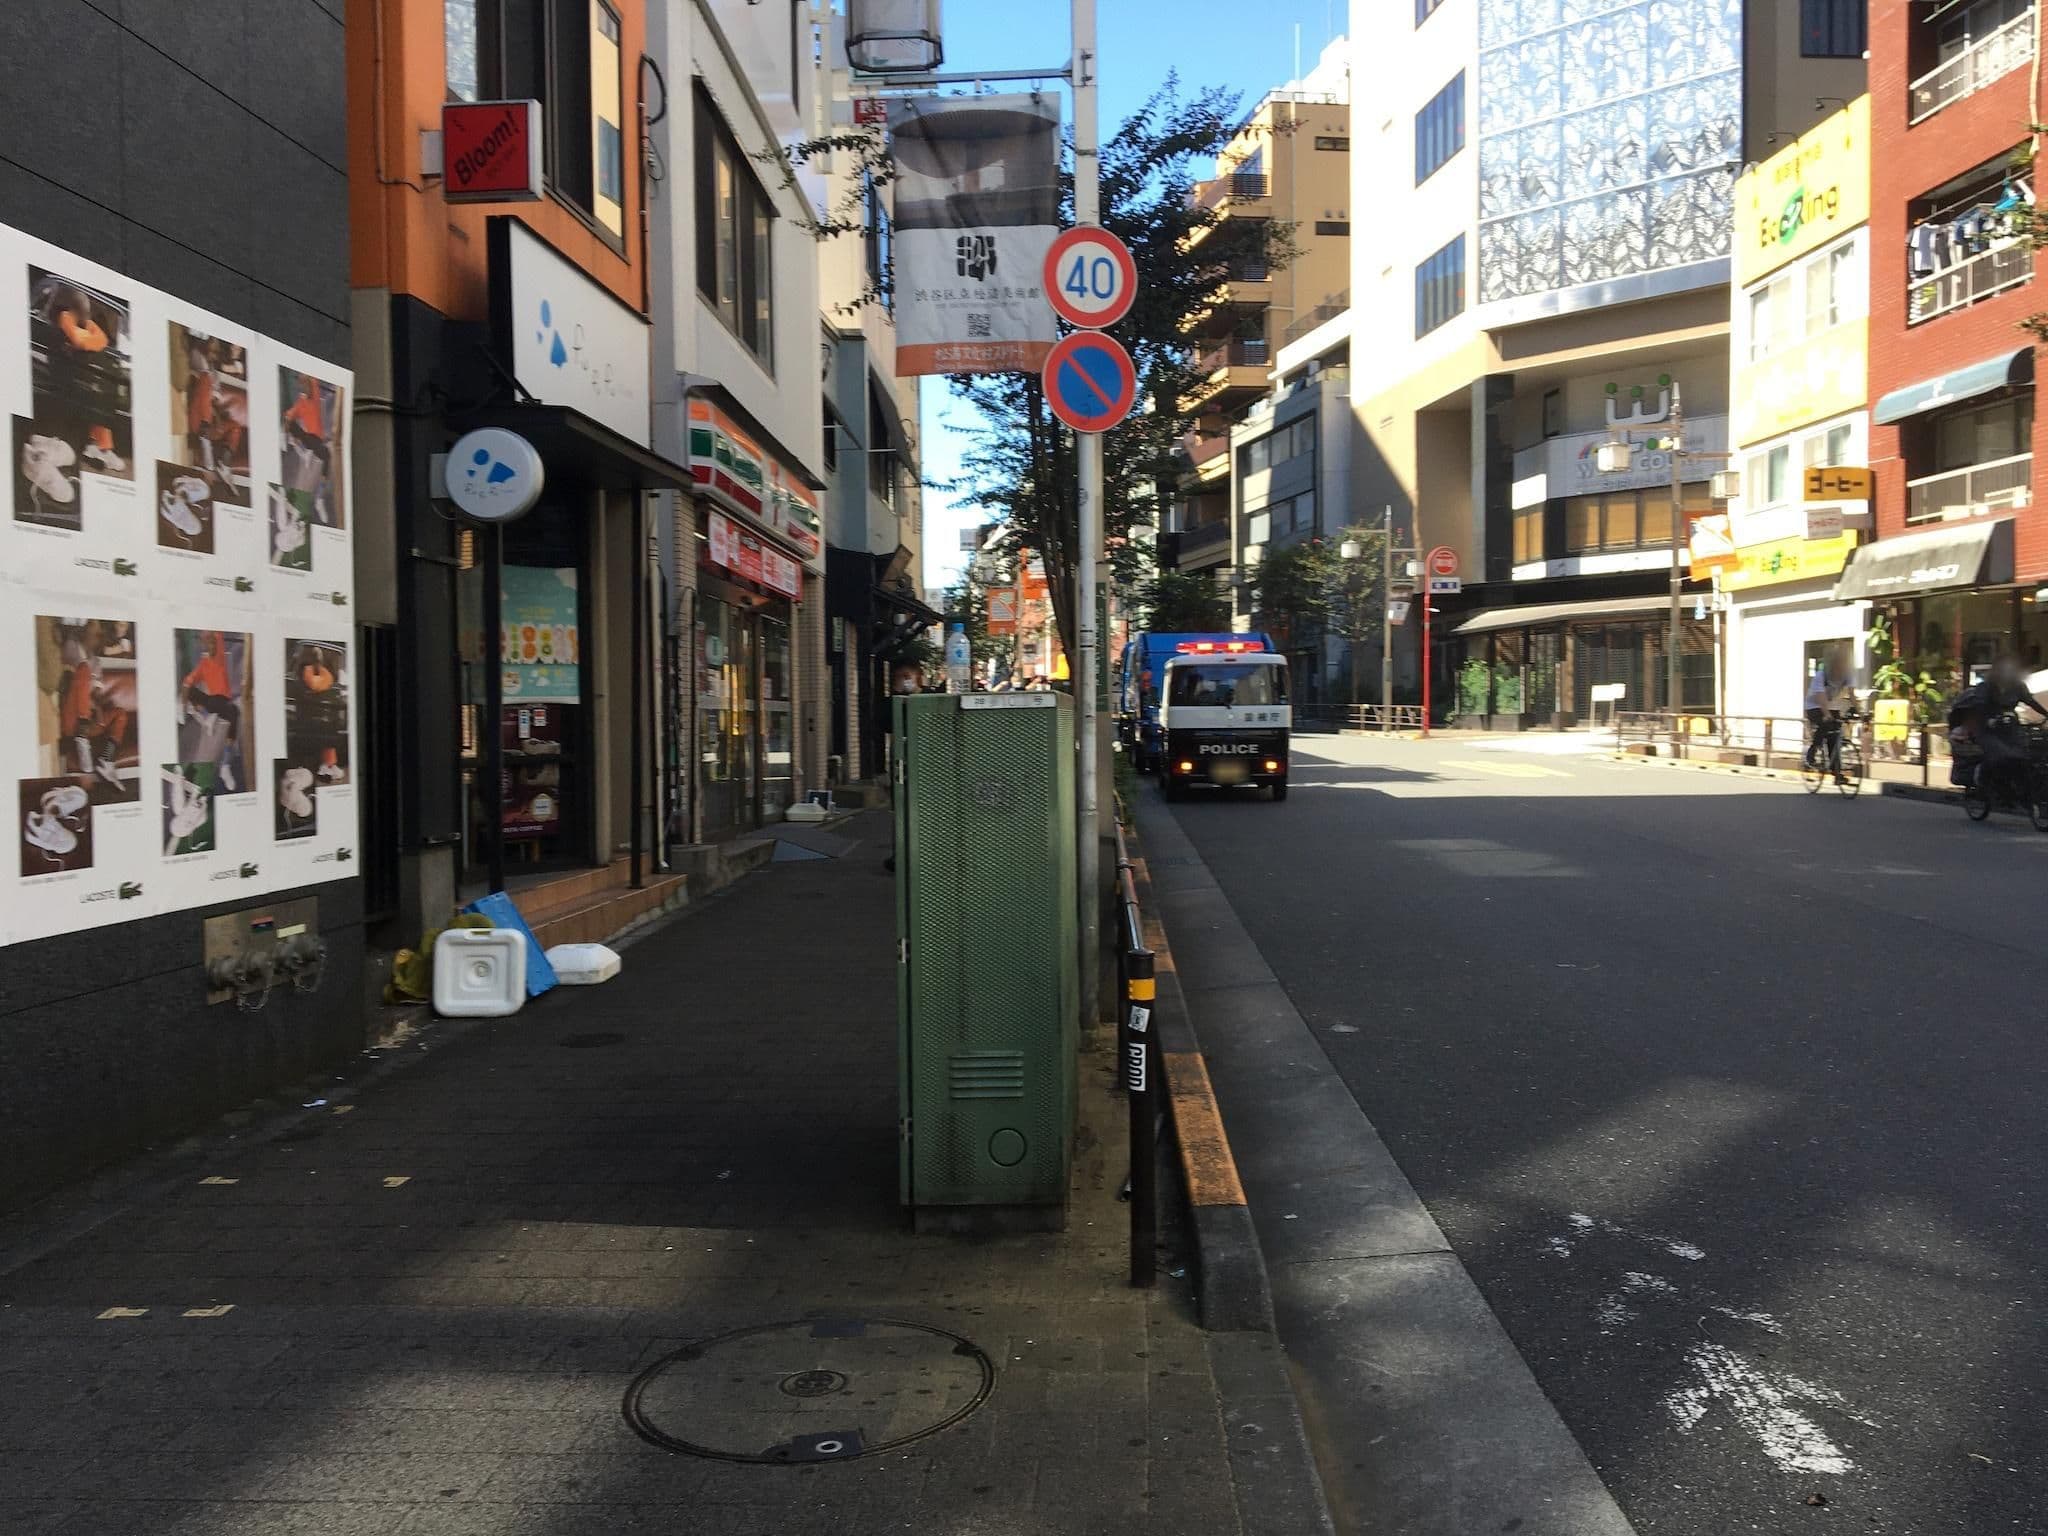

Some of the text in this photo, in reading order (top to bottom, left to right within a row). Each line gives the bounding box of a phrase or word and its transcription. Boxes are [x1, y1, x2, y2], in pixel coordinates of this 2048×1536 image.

[453, 110, 520, 186] Bloom!
[1065, 255, 1115, 299] 40
[1808, 473, 1864, 494] コーヒー
[1200, 744, 1259, 755] POLICE
